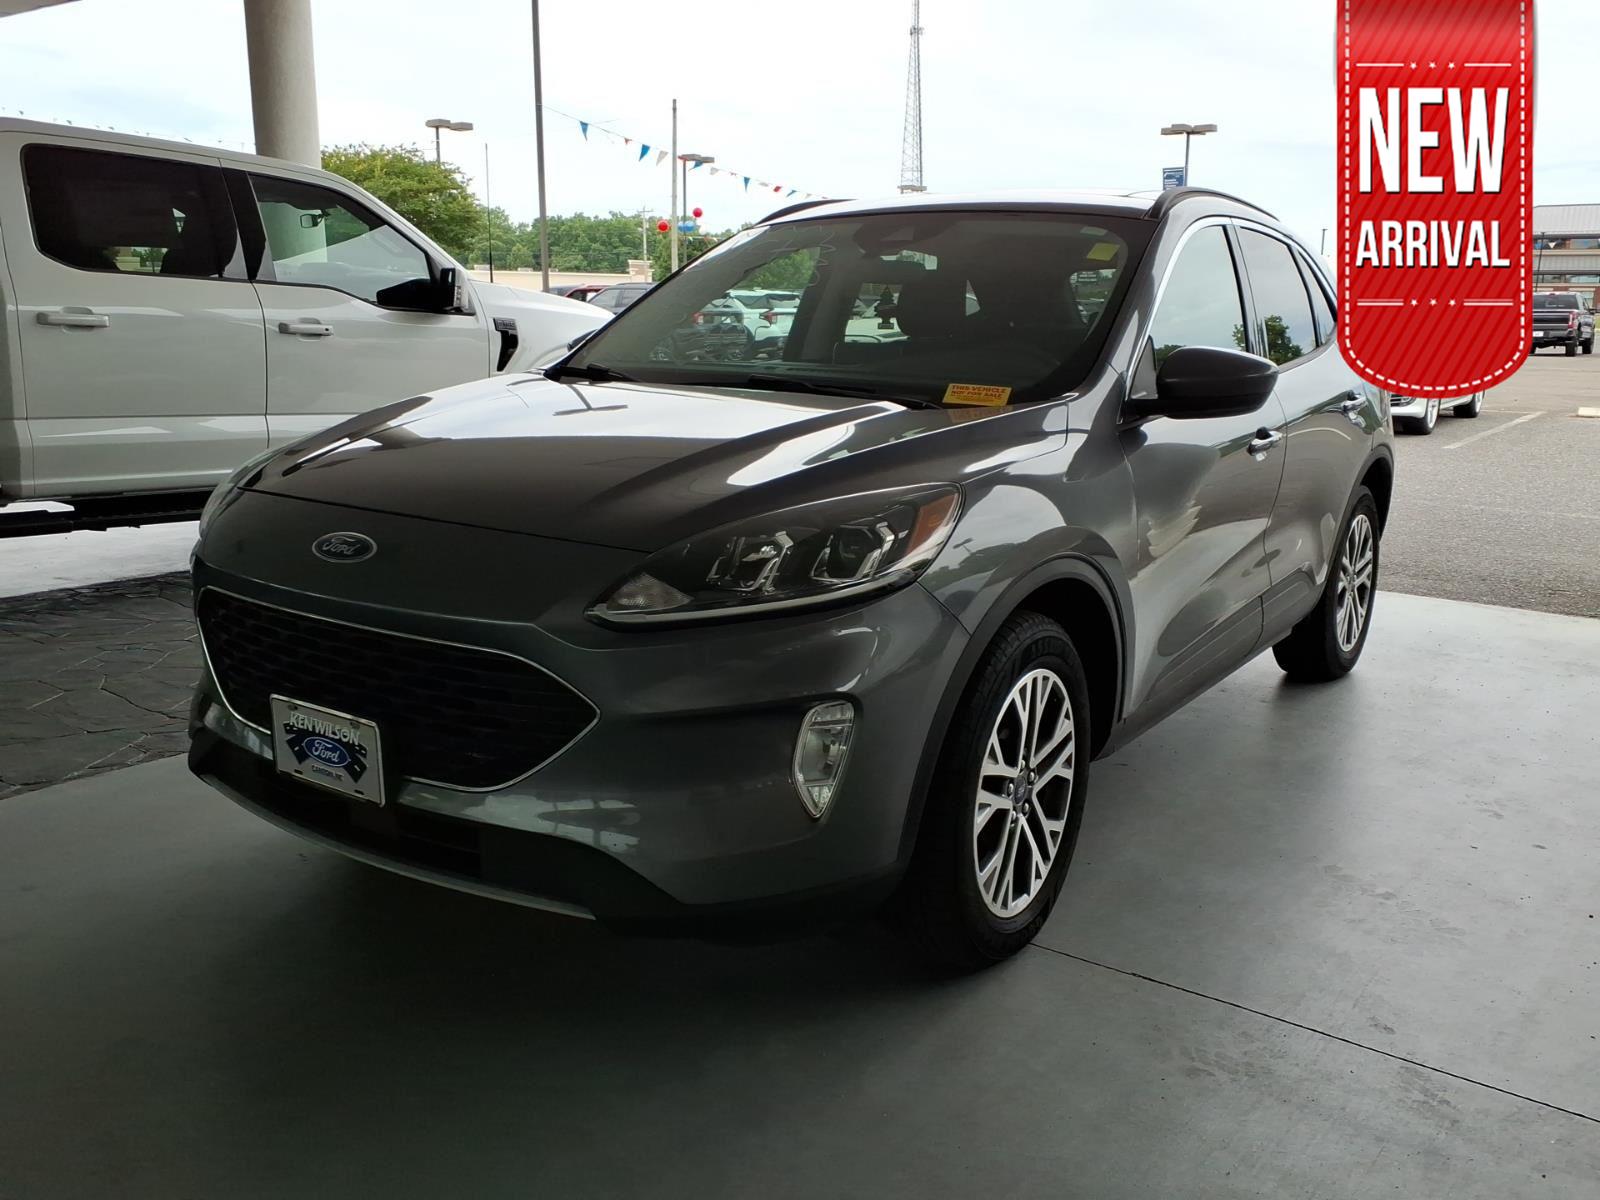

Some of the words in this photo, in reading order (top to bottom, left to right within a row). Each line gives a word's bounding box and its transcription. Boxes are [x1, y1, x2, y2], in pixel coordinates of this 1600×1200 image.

[322, 536, 361, 555] Ford
[290, 711, 313, 731] KEN
[314, 718, 360, 745] WILSON
[312, 739, 340, 762] Ford
